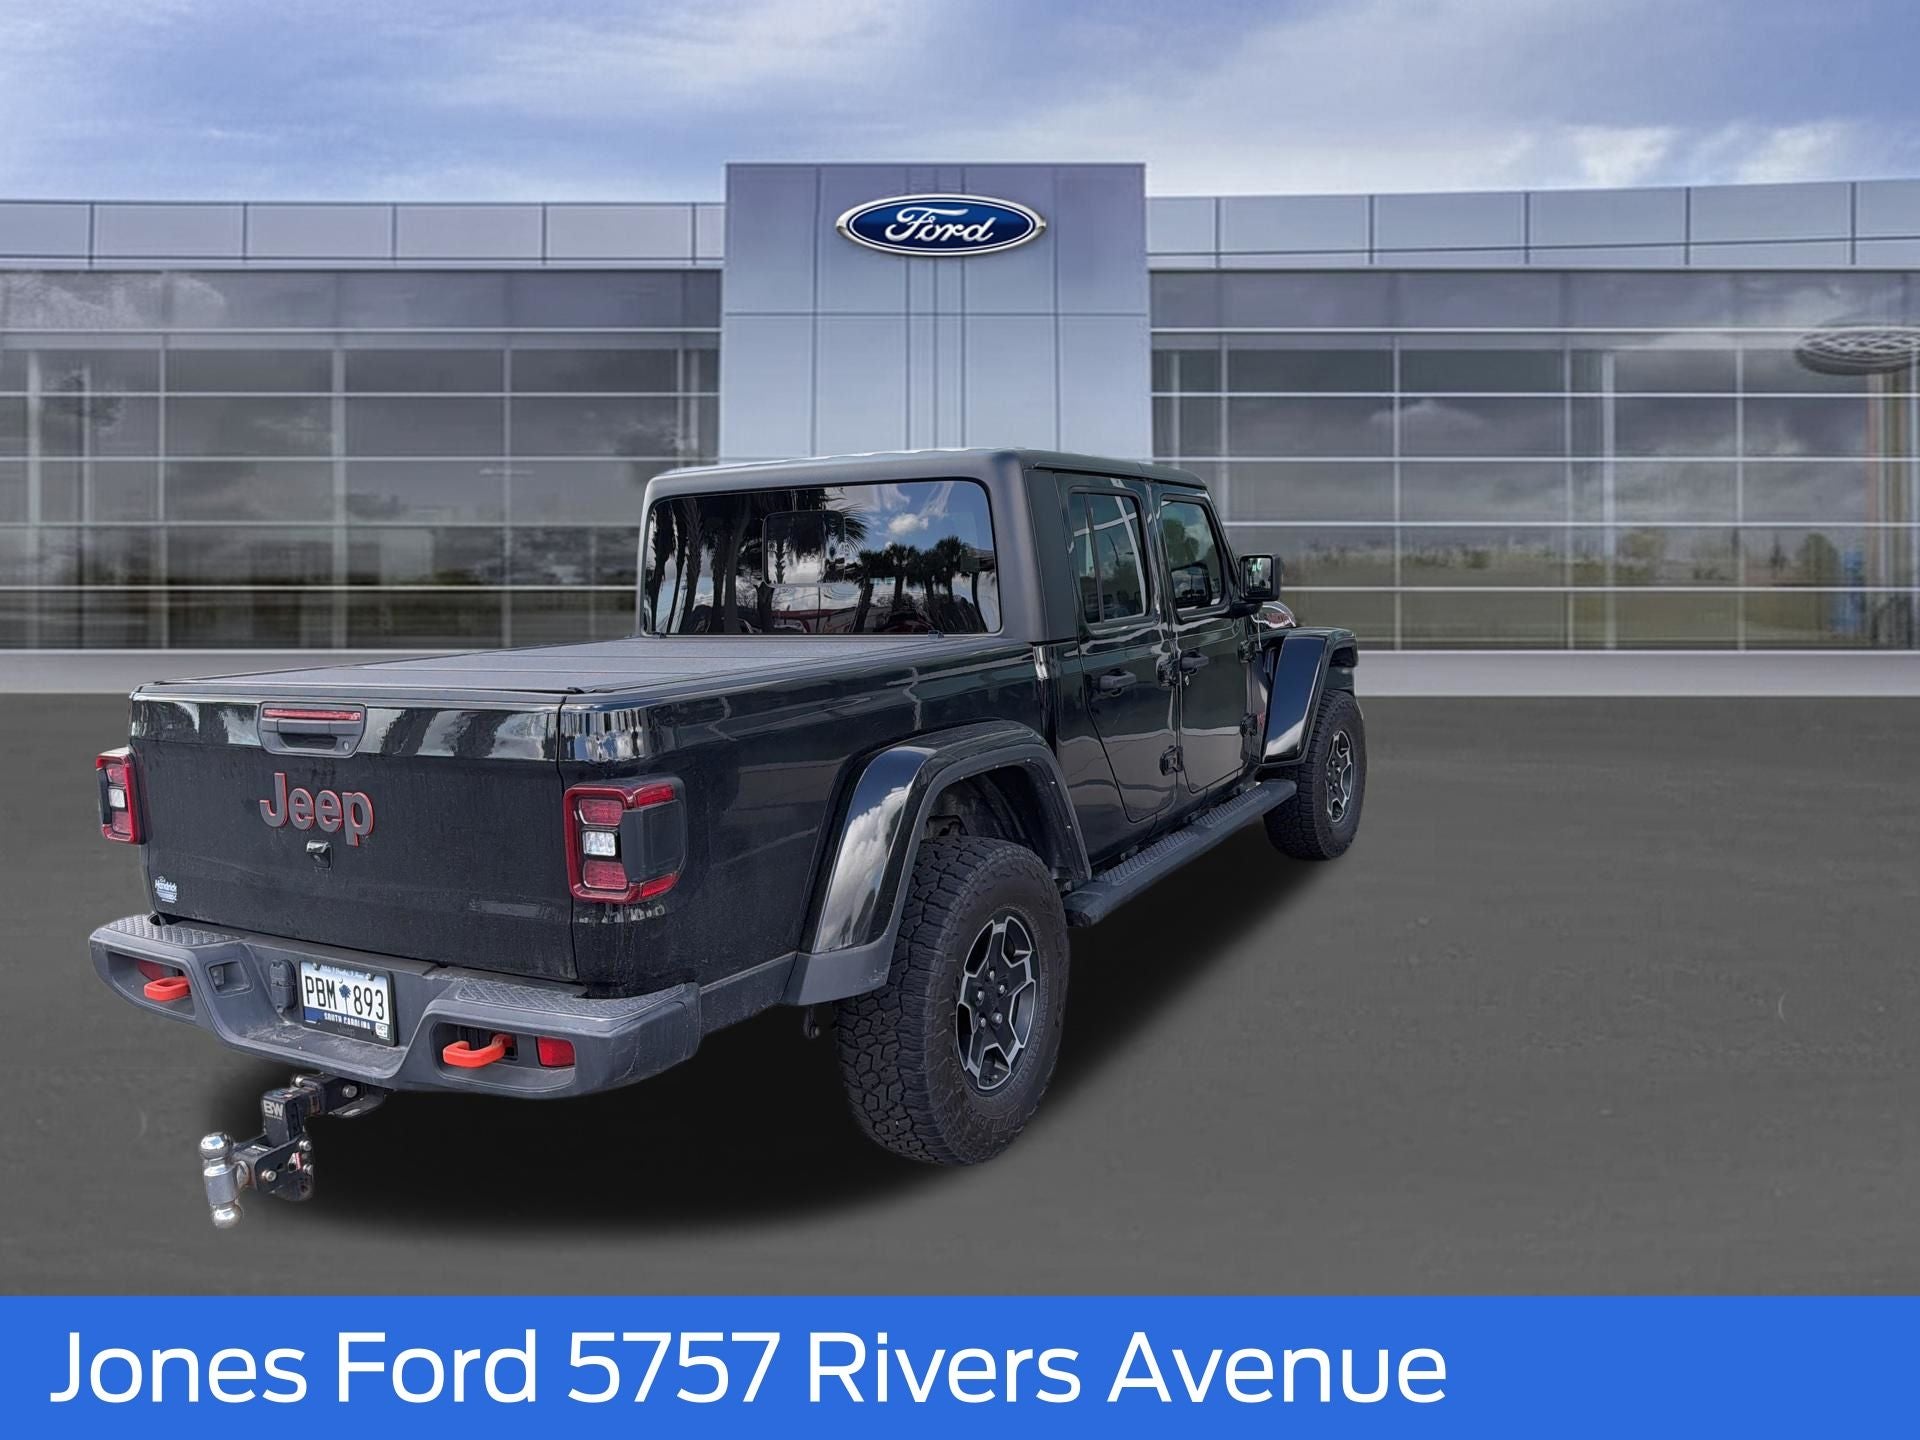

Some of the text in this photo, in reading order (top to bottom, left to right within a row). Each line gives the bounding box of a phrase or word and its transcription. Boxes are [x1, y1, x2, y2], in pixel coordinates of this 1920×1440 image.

[884, 206, 997, 242] Ford
[259, 771, 374, 847] Jeep
[304, 975, 385, 1021] PBM 893
[323, 1011, 371, 1030] SOUTH CAROLINA
